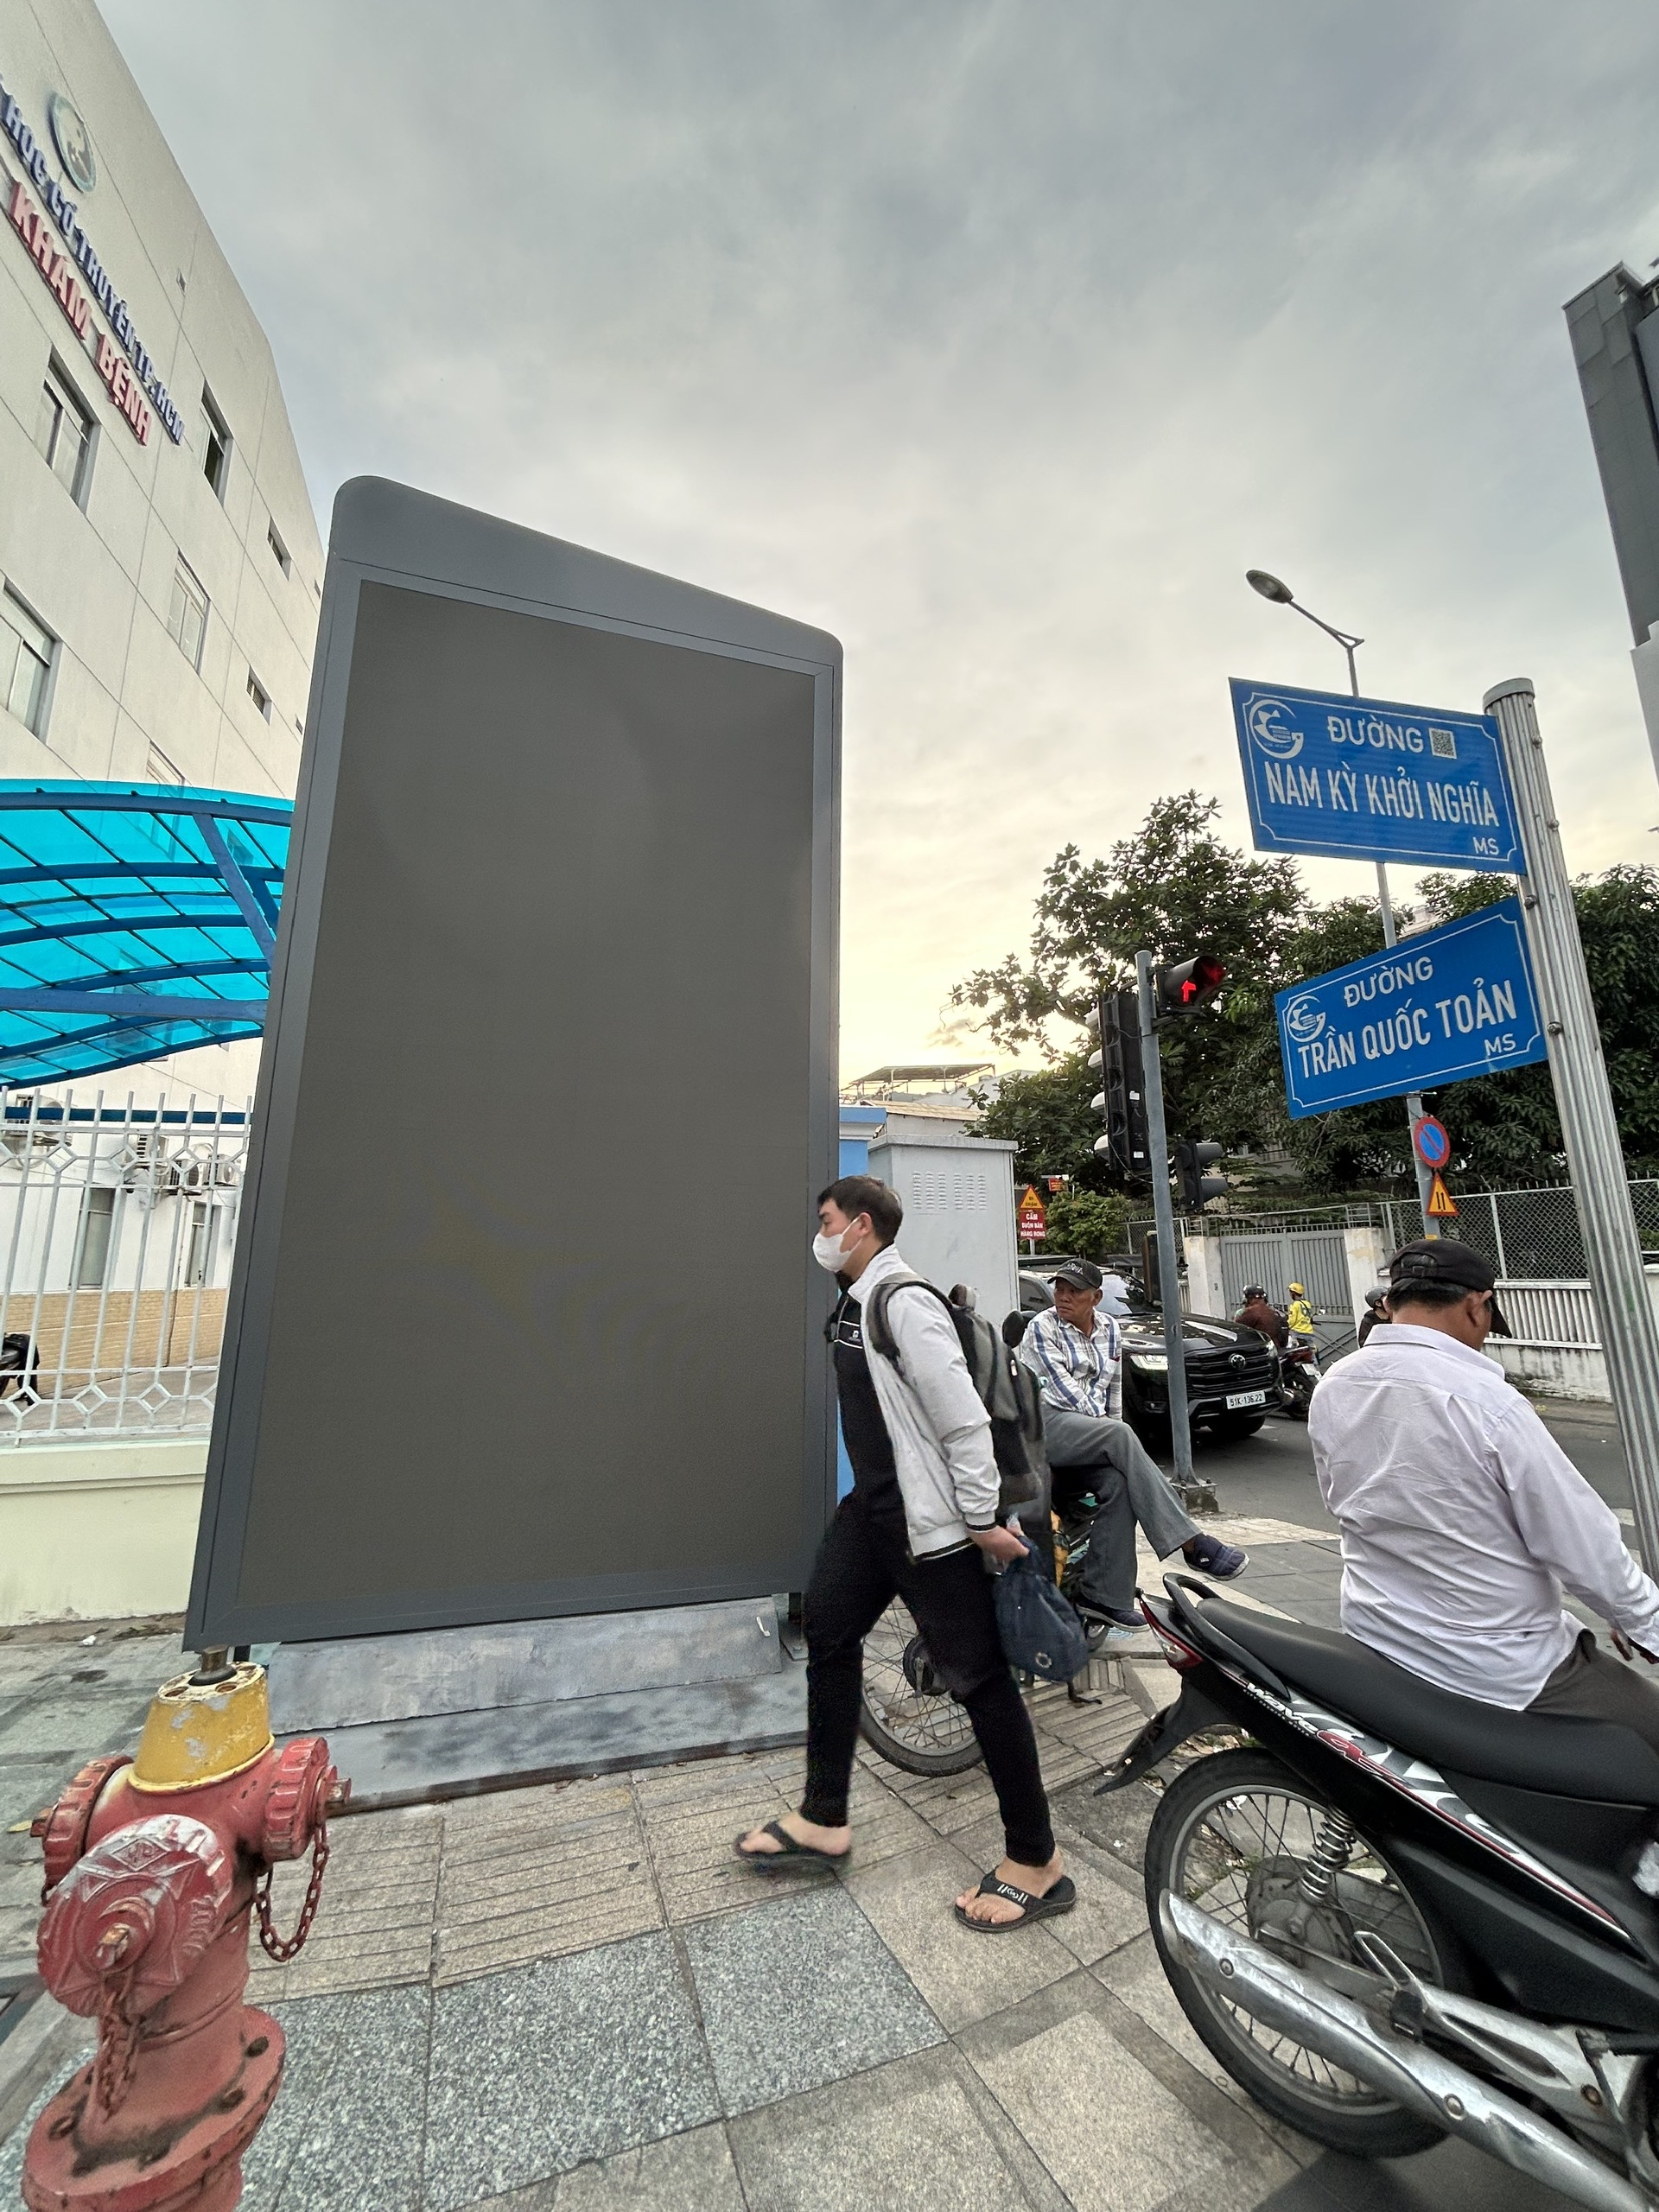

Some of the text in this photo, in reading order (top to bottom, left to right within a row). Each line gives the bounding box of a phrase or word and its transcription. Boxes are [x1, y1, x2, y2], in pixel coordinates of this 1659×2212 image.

[10, 181, 152, 446] KHÁM BỆNH
[1327, 715, 1424, 753] ĐƯỜNG
[1265, 761, 1500, 827] NAM KỲ KHỞI NGHĨA
[1473, 836, 1500, 856] MS
[1344, 957, 1434, 1007] ĐƯỜNG
[1298, 977, 1517, 1078] TRẦN QUỐC TOẢN
[1484, 1033, 1517, 1056] MS
